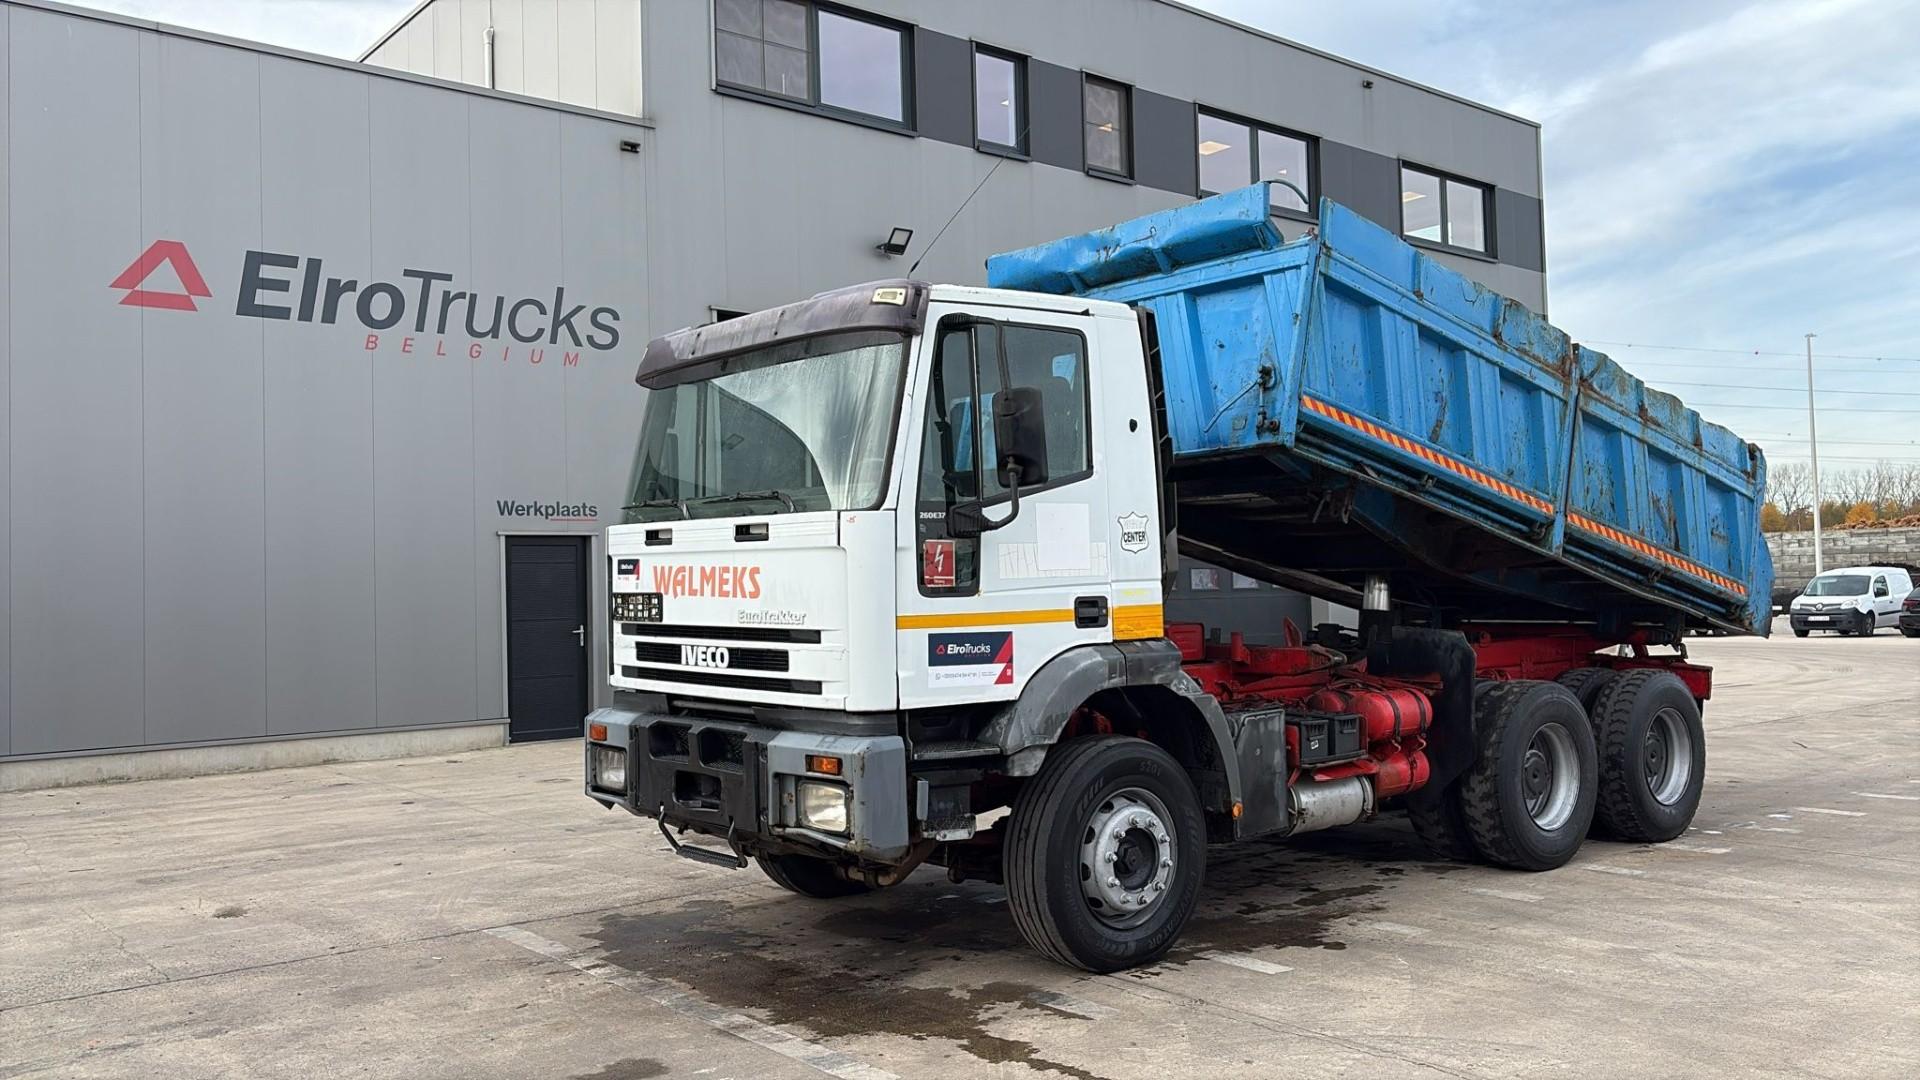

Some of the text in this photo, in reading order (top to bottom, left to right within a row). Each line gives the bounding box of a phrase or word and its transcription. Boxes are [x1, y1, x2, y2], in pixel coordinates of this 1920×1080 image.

[235, 250, 621, 351] ElroTrucks
[365, 334, 580, 367] BELGIUM
[496, 500, 599, 519] Werkplaats
[1123, 531, 1146, 543] CENTER
[653, 565, 761, 599] WALMEKS
[680, 645, 730, 668] IVECO
[947, 643, 991, 655] ElroTrucks
